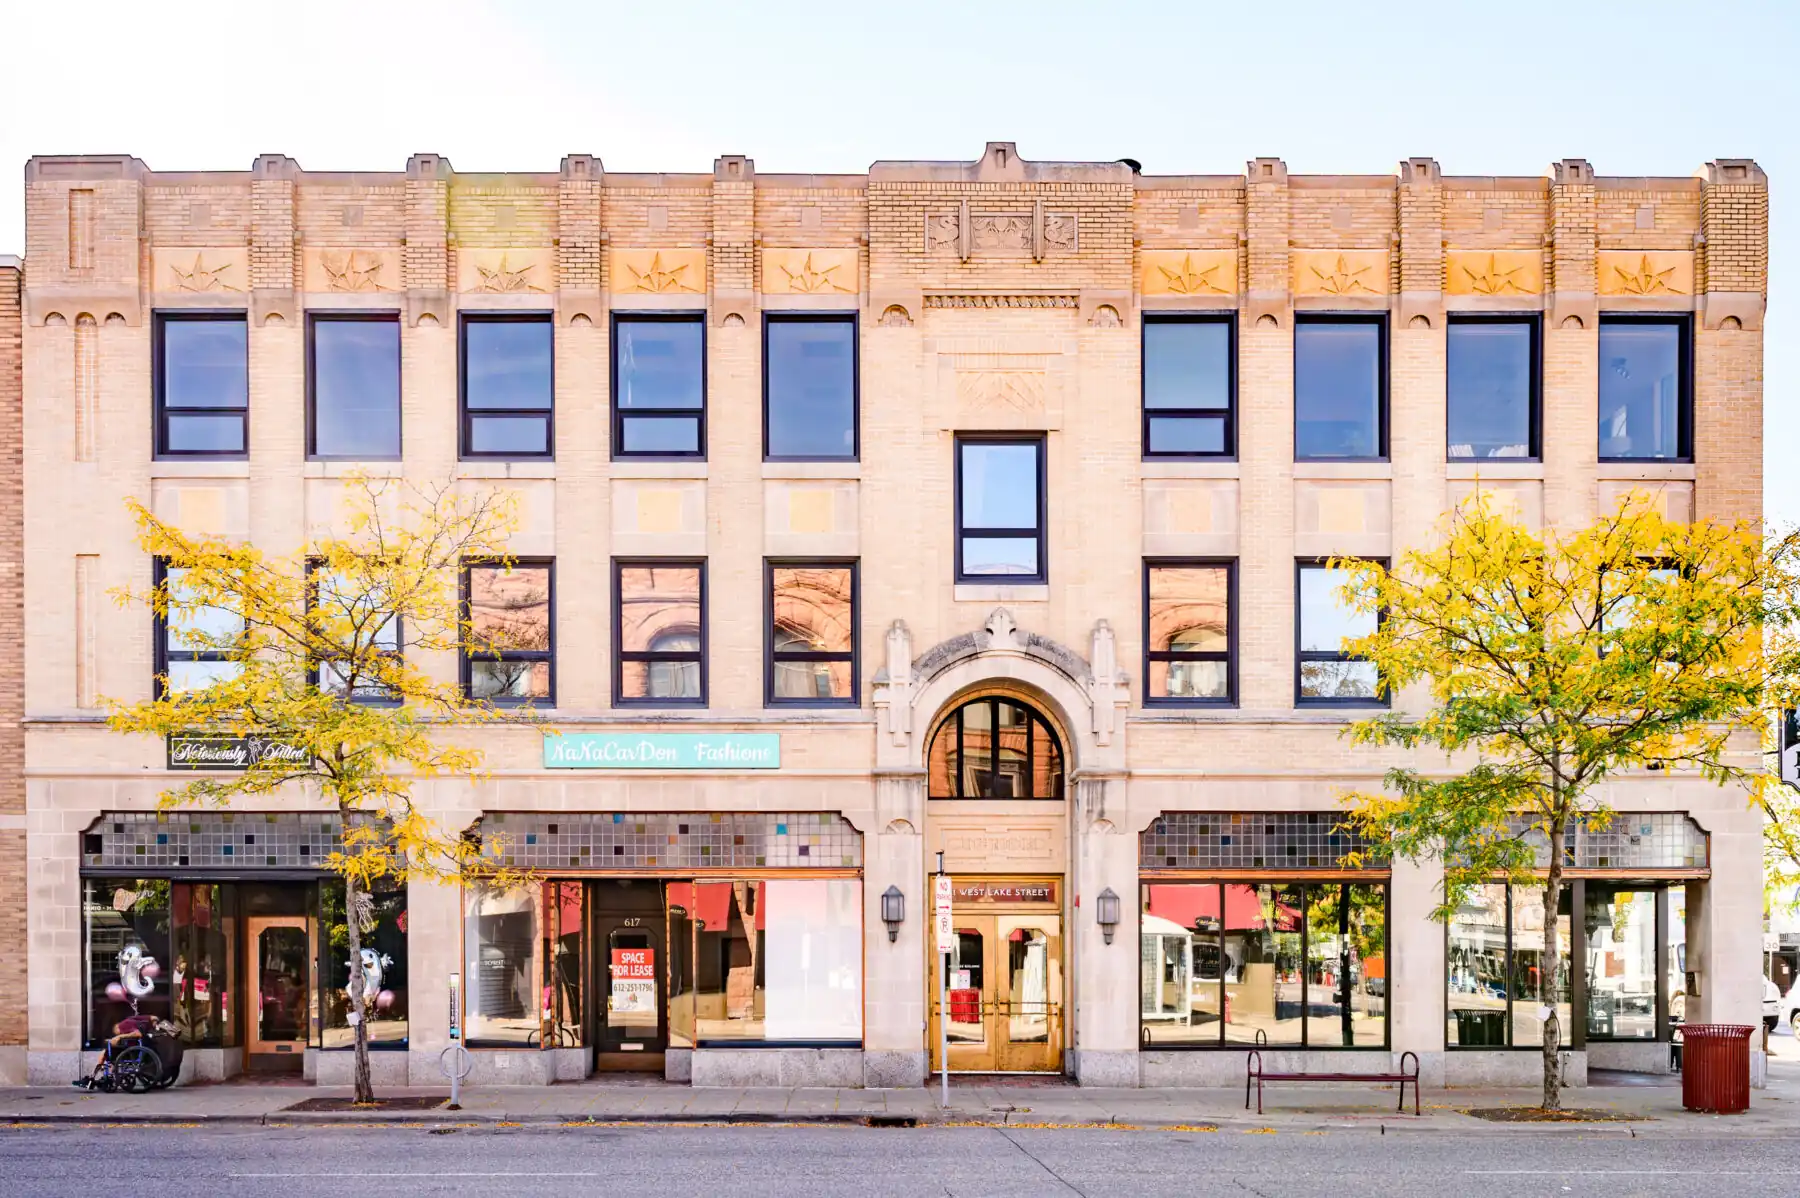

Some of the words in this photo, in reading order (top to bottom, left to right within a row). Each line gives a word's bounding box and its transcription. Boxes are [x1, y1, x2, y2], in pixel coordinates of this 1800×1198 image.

[694, 741, 771, 762] Fashions
[959, 888, 984, 896] WEST
[987, 888, 1012, 896] LAKE
[1015, 888, 1050, 896] STREET
[624, 918, 641, 927] 617
[621, 952, 645, 964] SPACE
[613, 964, 629, 976] FOR
[630, 964, 654, 976] LEASE
